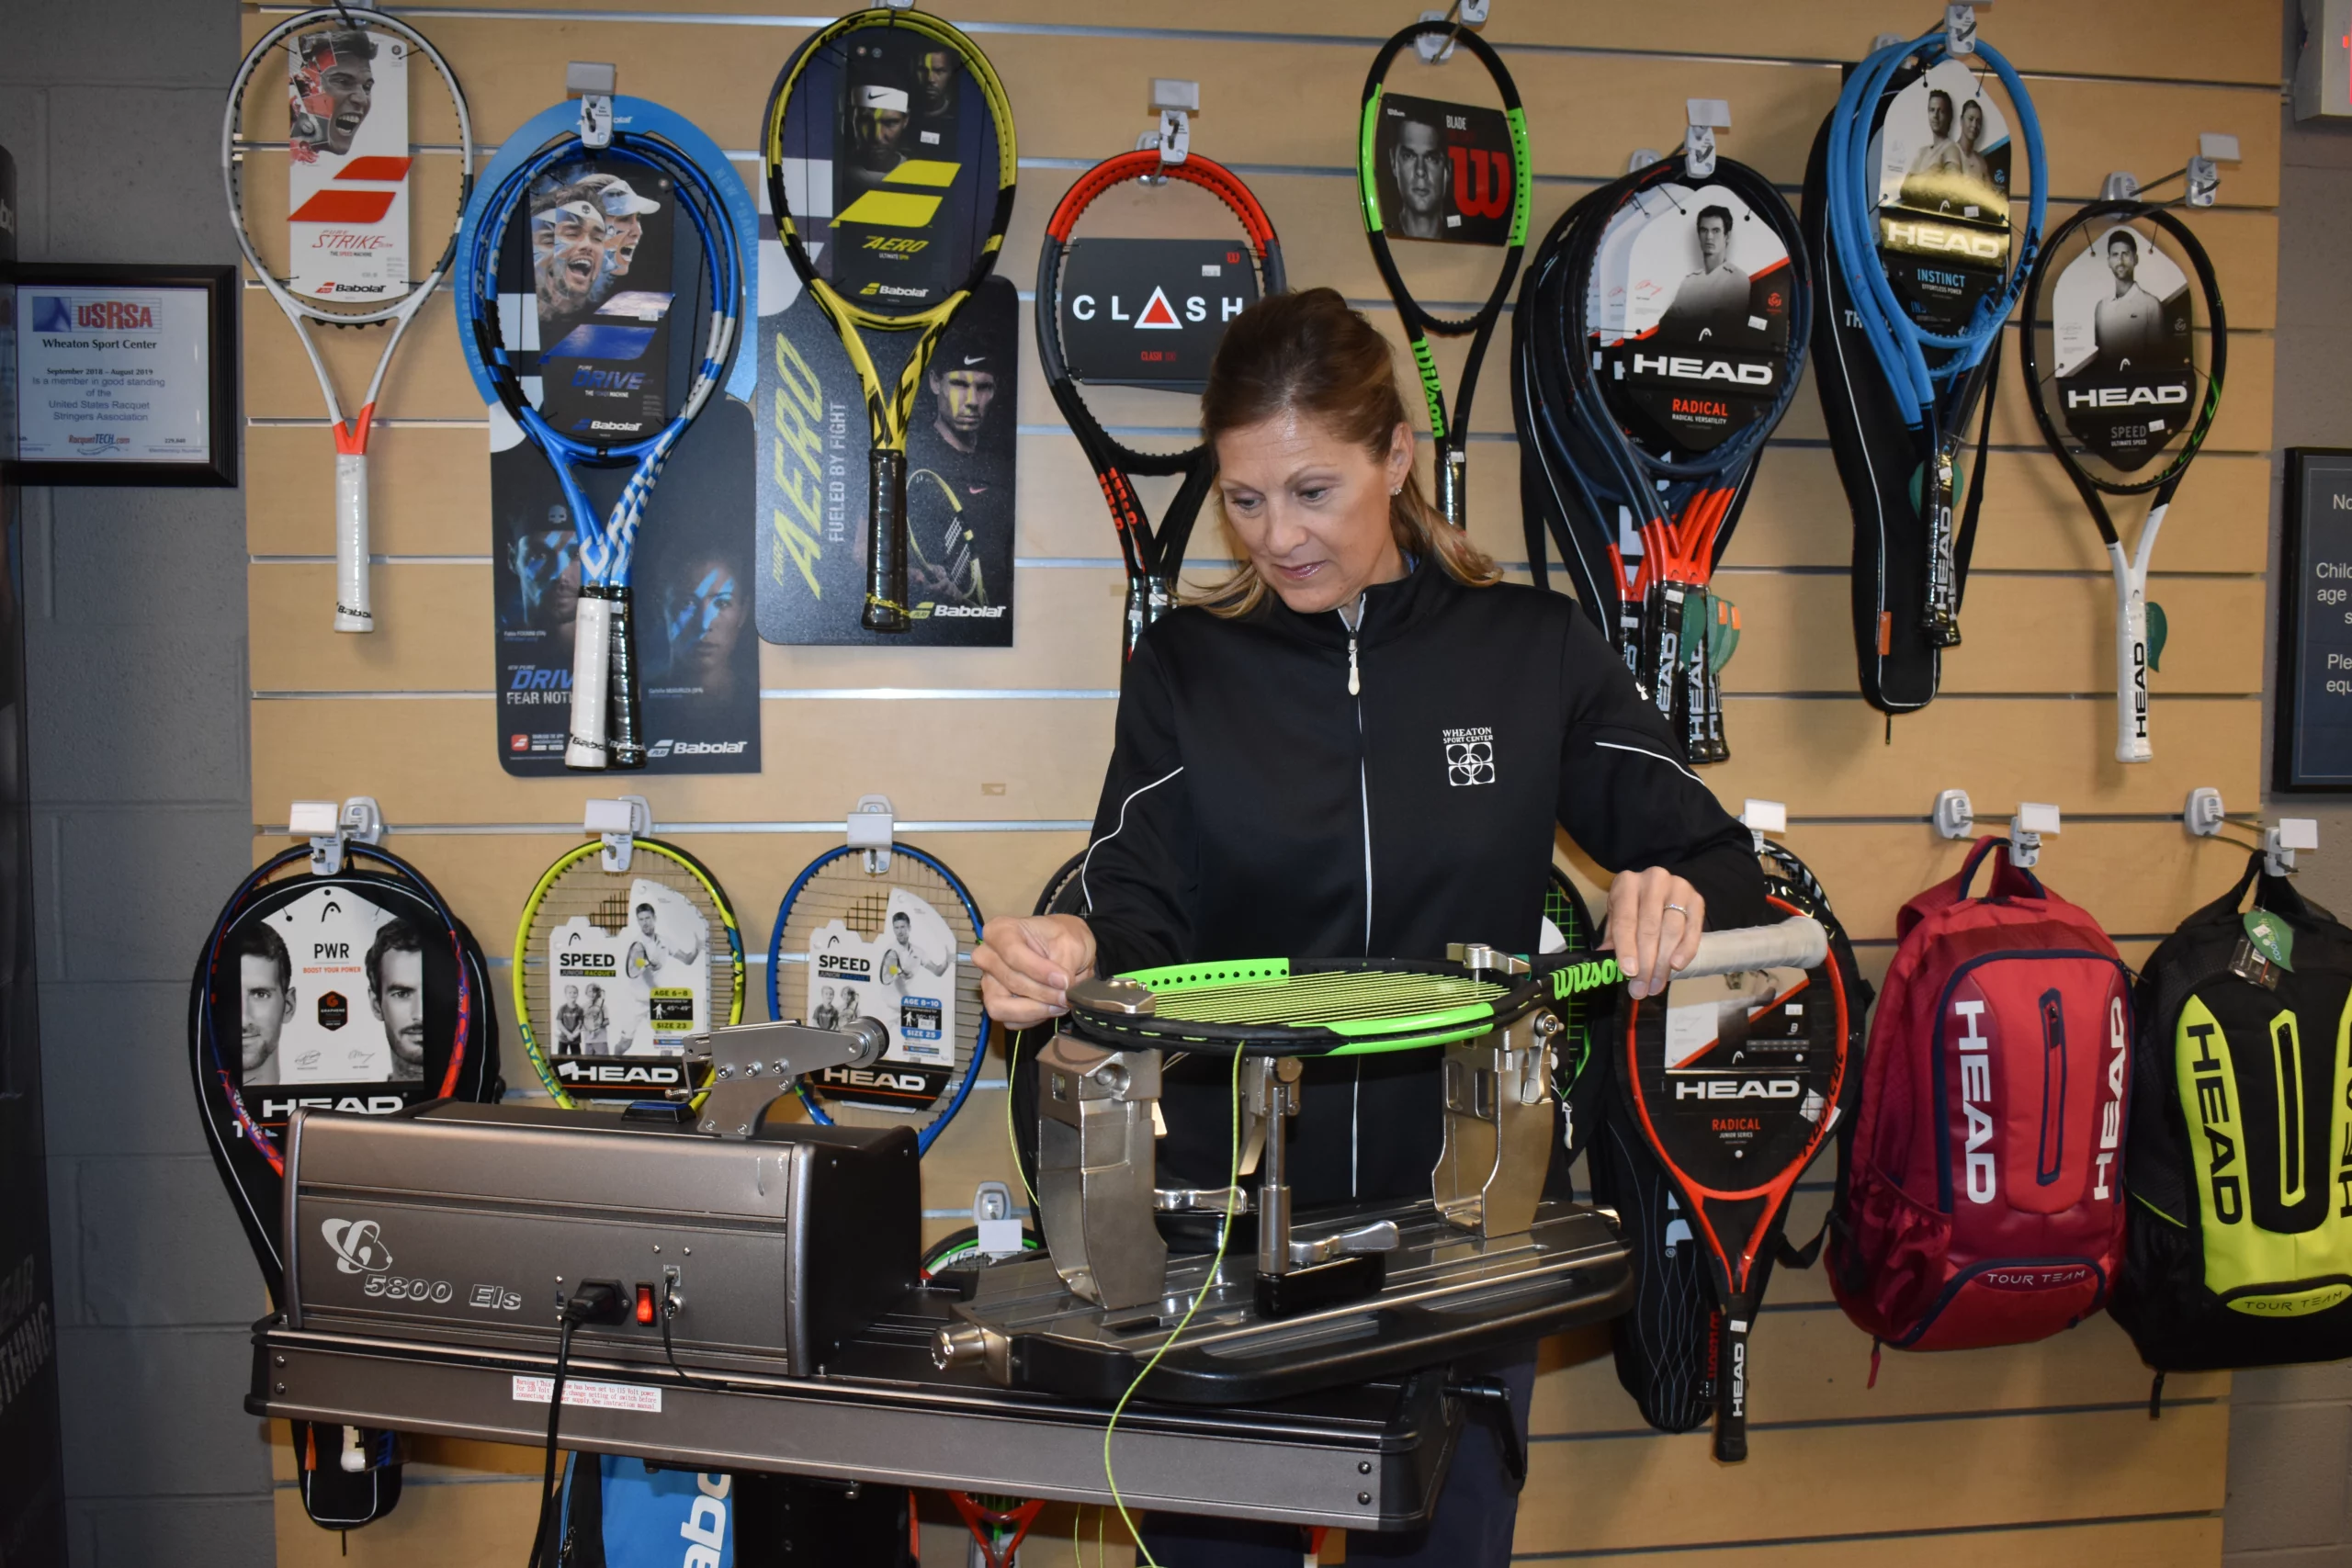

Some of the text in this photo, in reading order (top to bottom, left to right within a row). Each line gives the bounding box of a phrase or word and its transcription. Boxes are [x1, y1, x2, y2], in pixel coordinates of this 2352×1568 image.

[1446, 115, 1466, 130] BLADE
[311, 234, 386, 249] STRIKE
[862, 237, 929, 253] AERO
[1887, 221, 2000, 259] HEAD
[1917, 268, 1966, 288] INSTINCT
[1947, 287, 1962, 295] POWER
[77, 301, 153, 330] USRSA
[42, 338, 157, 351] Wheaton Sport Center
[1140, 351, 1162, 361] CLASH
[47, 368, 84, 377] September
[110, 368, 134, 377] August
[1634, 353, 1773, 386] HEAD
[51, 378, 88, 386] member
[91, 377, 99, 385] in
[102, 378, 124, 388] good
[127, 378, 165, 388] standing
[571, 370, 646, 389] DRIVE
[1411, 336, 1445, 438] Wilson
[85, 389, 111, 397] of the
[2067, 385, 2188, 409] HEAD
[49, 400, 150, 411] United States Racquet
[1672, 398, 1728, 416] RADICAL
[53, 412, 148, 422] Stringers Association
[1672, 413, 1726, 424] RADICAL VERSATILITY
[2110, 425, 2146, 439] SPEED
[774, 333, 822, 601] AERO
[829, 402, 847, 543] FUELED BY FIGHT
[1935, 506, 1951, 610] HEAD
[2316, 589, 2347, 604] age
[511, 669, 574, 690] DRIV
[1657, 632, 1679, 721] EAD
[507, 692, 540, 705] FEAR
[2133, 641, 2147, 739] HEAD
[1442, 727, 1492, 738] WHEATON
[1465, 734, 1494, 742] CENTER
[314, 942, 349, 959] PWR
[560, 953, 616, 967] SPEED
[819, 954, 870, 972] SPEED
[341, 965, 361, 974] POWER
[904, 998, 939, 1008] AGE 8-10
[907, 1029, 923, 1037] SIZE
[572, 1065, 679, 1083] HEAD
[824, 1067, 926, 1091] HEAD
[1676, 1080, 1800, 1100] HEAD
[2094, 996, 2127, 1201] HEAD
[1955, 999, 1996, 1205] HEAD
[1712, 1118, 1761, 1132] RADICAL
[2187, 1022, 2244, 1226] HEAD
[1987, 1269, 2086, 1286] TOUR TEAM
[364, 1273, 453, 1303] 5800
[2245, 1291, 2344, 1312] TOUR TEAM
[1733, 1342, 1745, 1417] HEAD
[516, 1392, 545, 1400] connecting
[604, 1400, 635, 1408] instruction
[589, 1392, 608, 1400] setting
[639, 1395, 657, 1404] before
